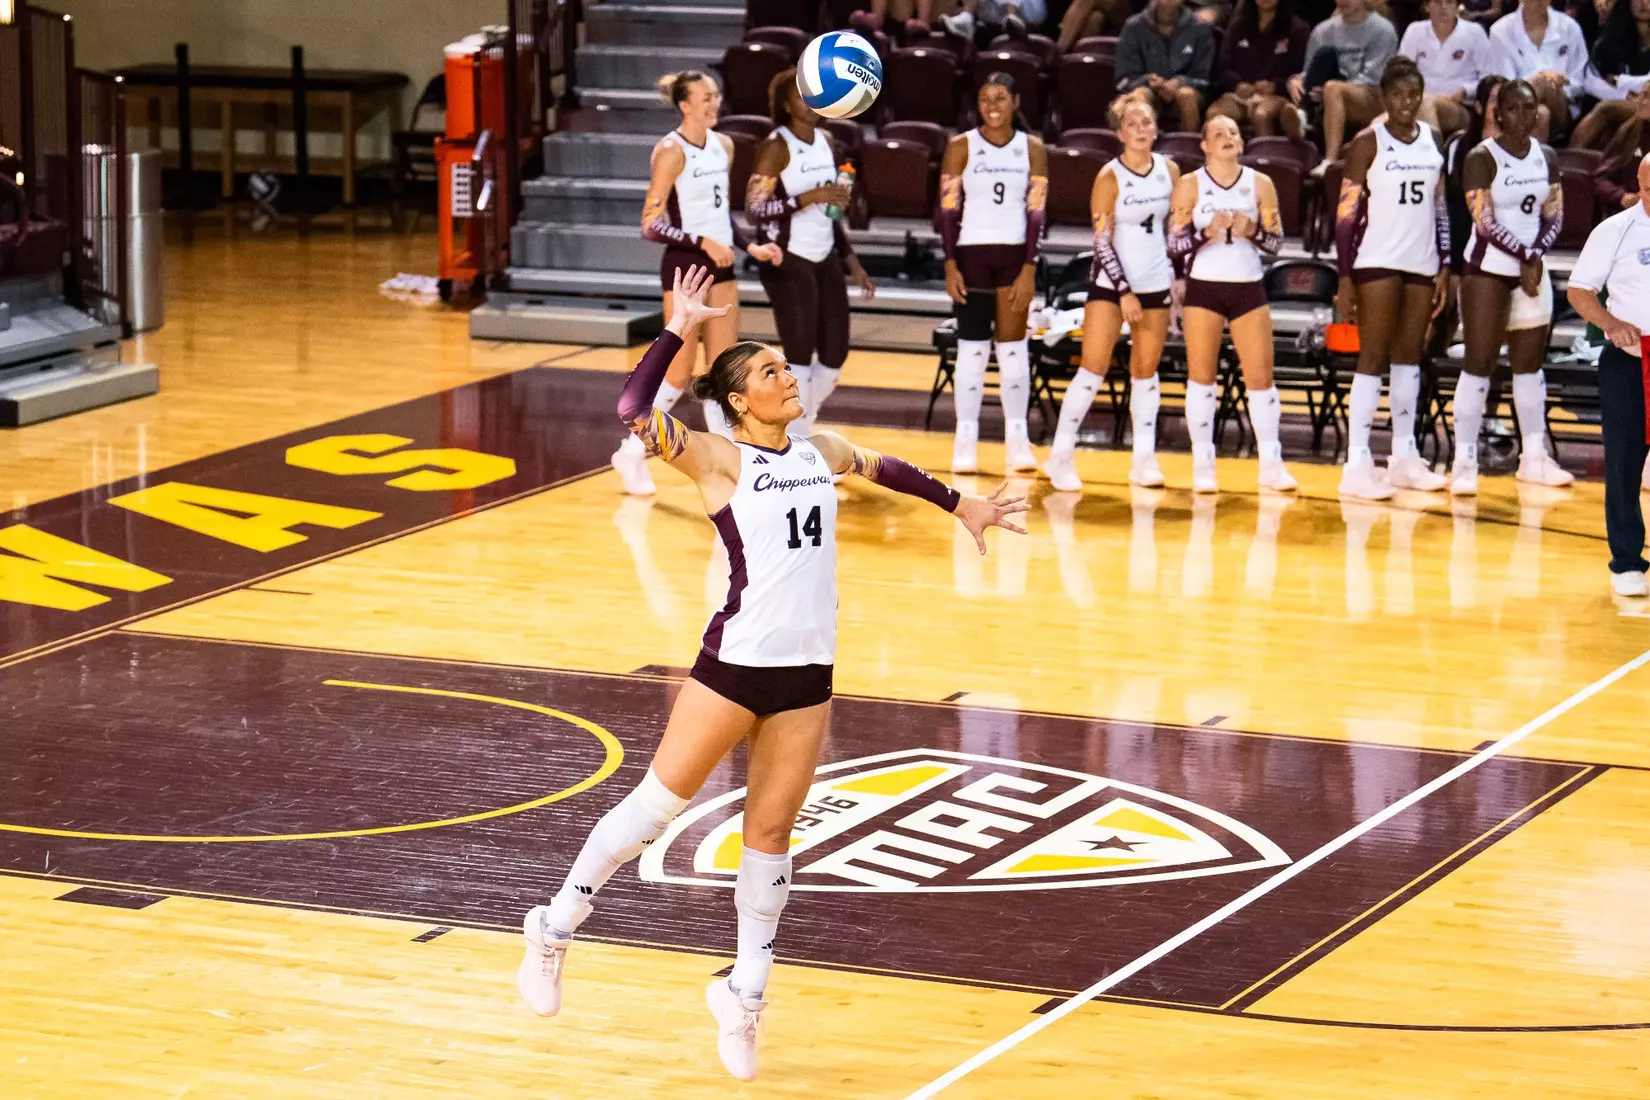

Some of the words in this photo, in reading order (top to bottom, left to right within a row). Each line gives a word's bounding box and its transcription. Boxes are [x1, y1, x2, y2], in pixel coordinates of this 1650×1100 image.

[847, 63, 881, 92] molten
[713, 184, 723, 209] 6
[992, 182, 1006, 205] 9
[1398, 180, 1425, 205] 15
[1520, 194, 1537, 215] 8
[1140, 213, 1155, 234] 4
[785, 505, 823, 549] 14
[796, 771, 1098, 889] MAC
